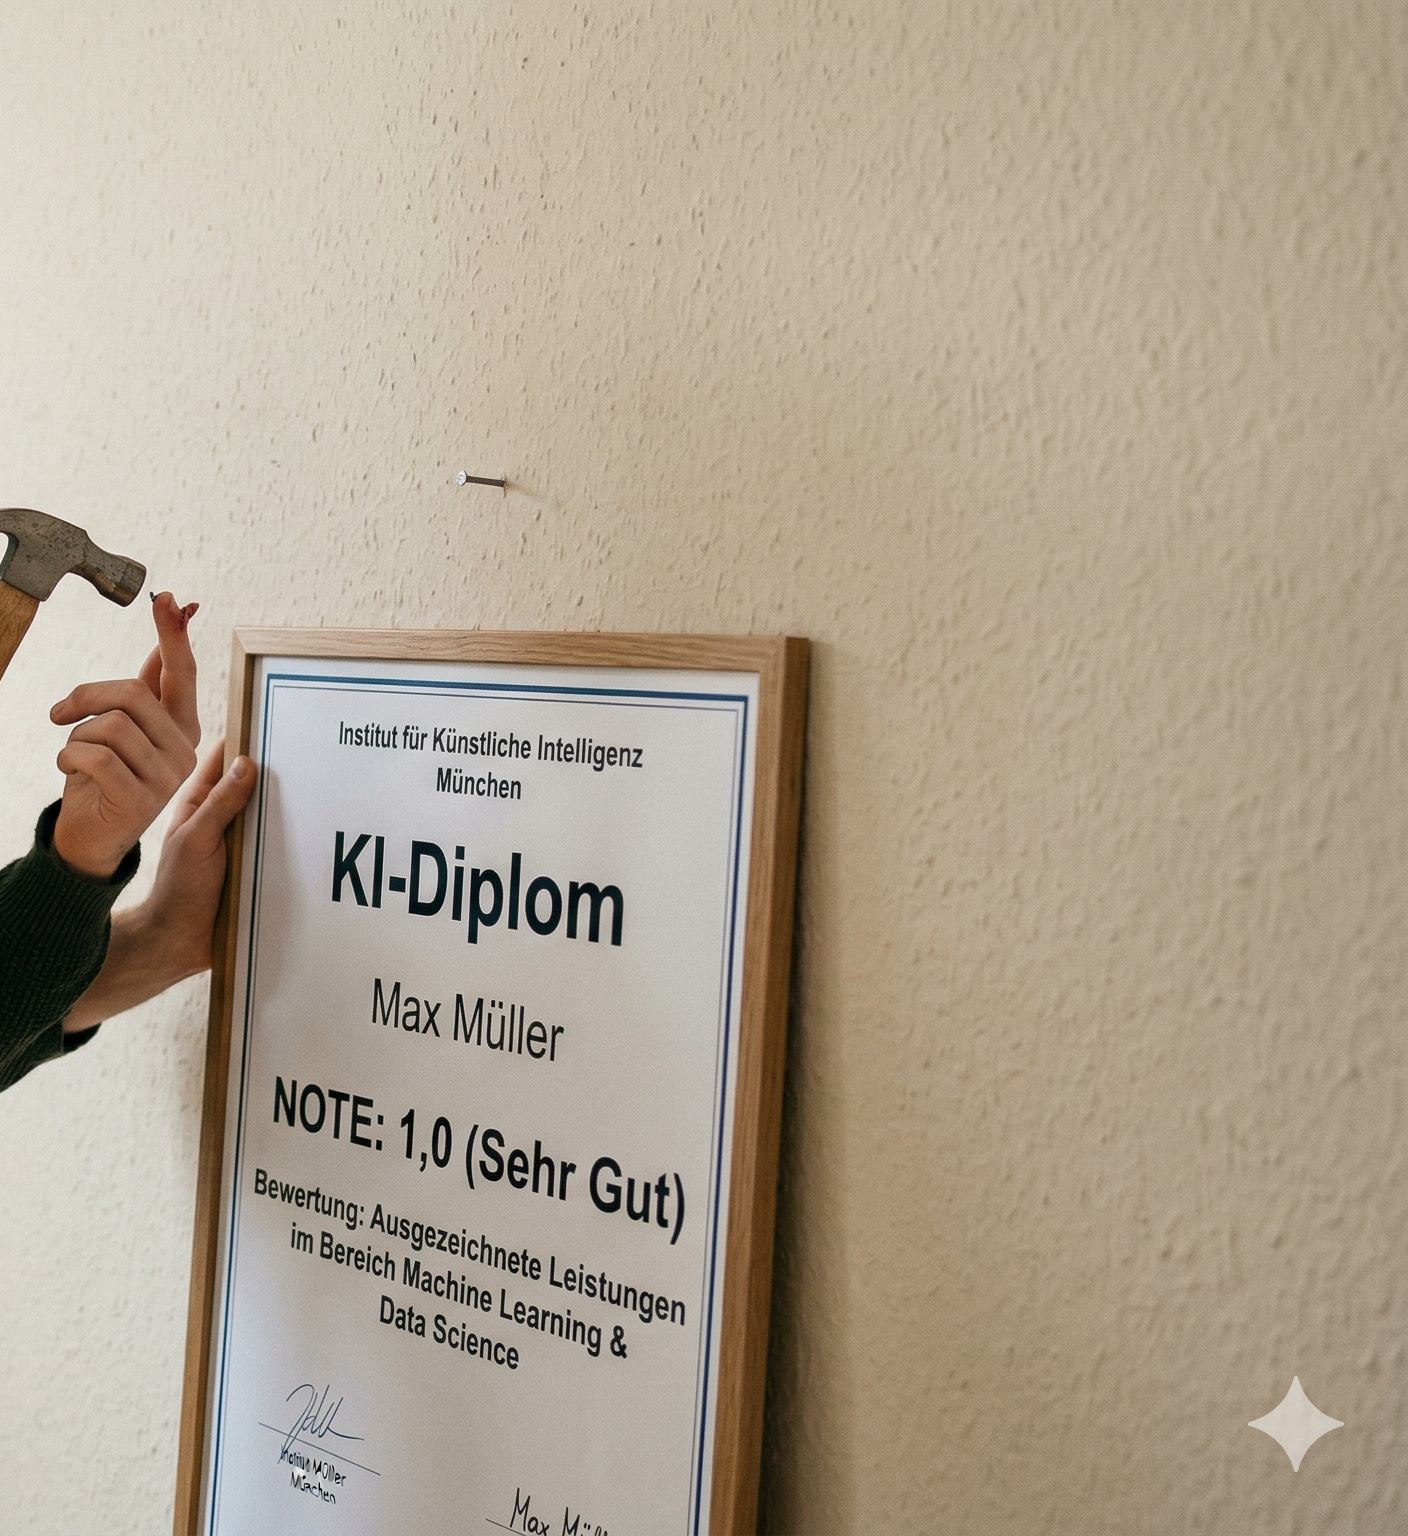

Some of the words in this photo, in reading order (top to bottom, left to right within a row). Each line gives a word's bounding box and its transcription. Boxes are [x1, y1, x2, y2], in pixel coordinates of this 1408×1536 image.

[338, 720, 398, 750] Institut
[402, 724, 429, 751] für
[432, 726, 532, 760] Künstliche
[537, 734, 644, 773] Intelligenz
[436, 766, 522, 801] München
[331, 830, 625, 946] KI-Diplom
[372, 977, 442, 1038] Max
[453, 993, 565, 1062] Müller
[273, 1075, 385, 1152] NOTE:
[400, 1108, 453, 1173] 1,0
[465, 1123, 577, 1202] (Sehr
[589, 1155, 686, 1246] Gut)
[253, 1167, 365, 1231] Bewertung:
[370, 1203, 542, 1281] Ausgezeichnete
[548, 1255, 686, 1327] Leistungen
[290, 1225, 314, 1255] im
[319, 1230, 396, 1282] Bereich
[402, 1256, 493, 1313] Machine
[499, 1288, 602, 1358] Learning
[609, 1324, 628, 1360] &
[379, 1294, 426, 1338] Data
[432, 1313, 520, 1370] Science
[509, 1487, 550, 1536] Max
